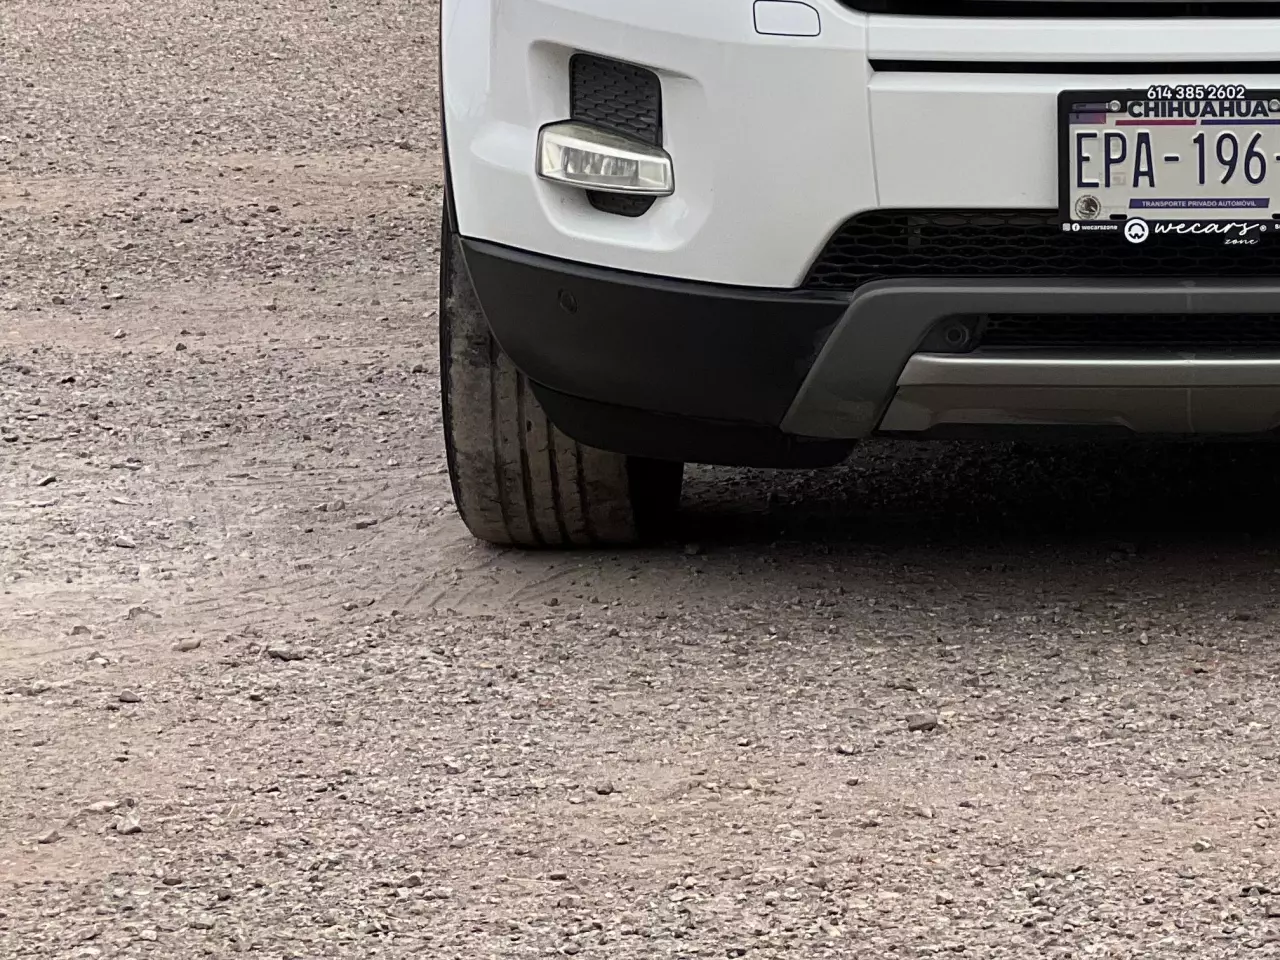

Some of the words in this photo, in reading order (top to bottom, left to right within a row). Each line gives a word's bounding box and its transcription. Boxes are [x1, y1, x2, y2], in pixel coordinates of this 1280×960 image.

[1147, 86, 1173, 99] 614
[1175, 86, 1204, 99] 385
[1207, 86, 1246, 99] 2602
[1127, 101, 1269, 118] CHIHUAHUA
[1218, 199, 1257, 207] AUTOMÓVIL
[1154, 221, 1260, 236] wecars
[1223, 237, 1259, 245] zone
